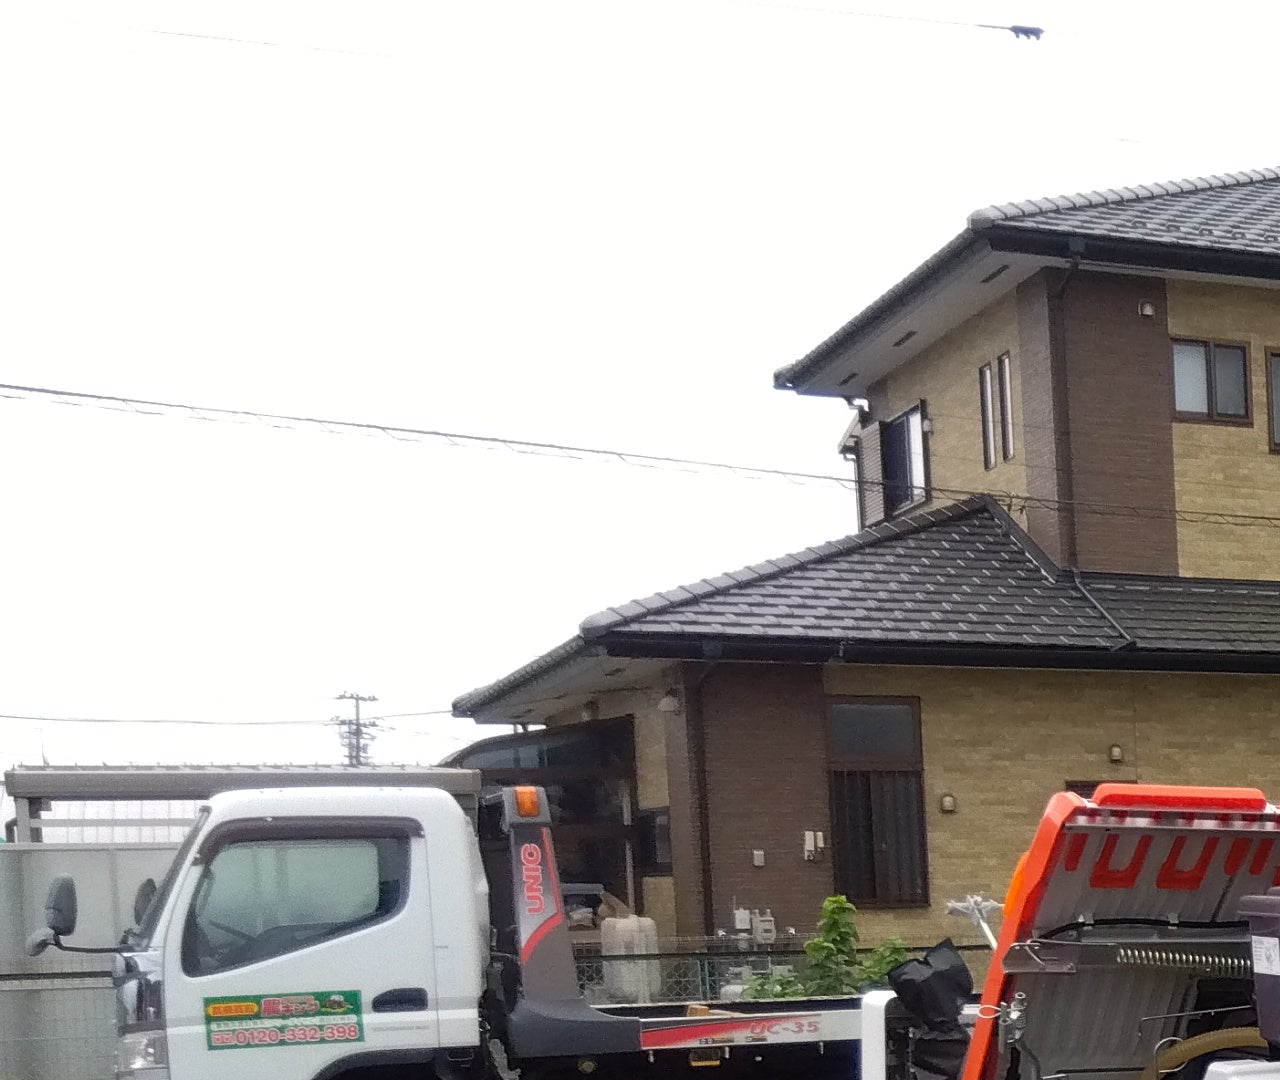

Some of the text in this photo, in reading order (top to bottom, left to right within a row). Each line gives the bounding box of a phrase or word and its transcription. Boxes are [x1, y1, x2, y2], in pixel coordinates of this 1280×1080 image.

[521, 843, 544, 915] UNIC
[235, 1024, 359, 1045] 0120-332-398
[749, 1021, 820, 1036] UC-35
